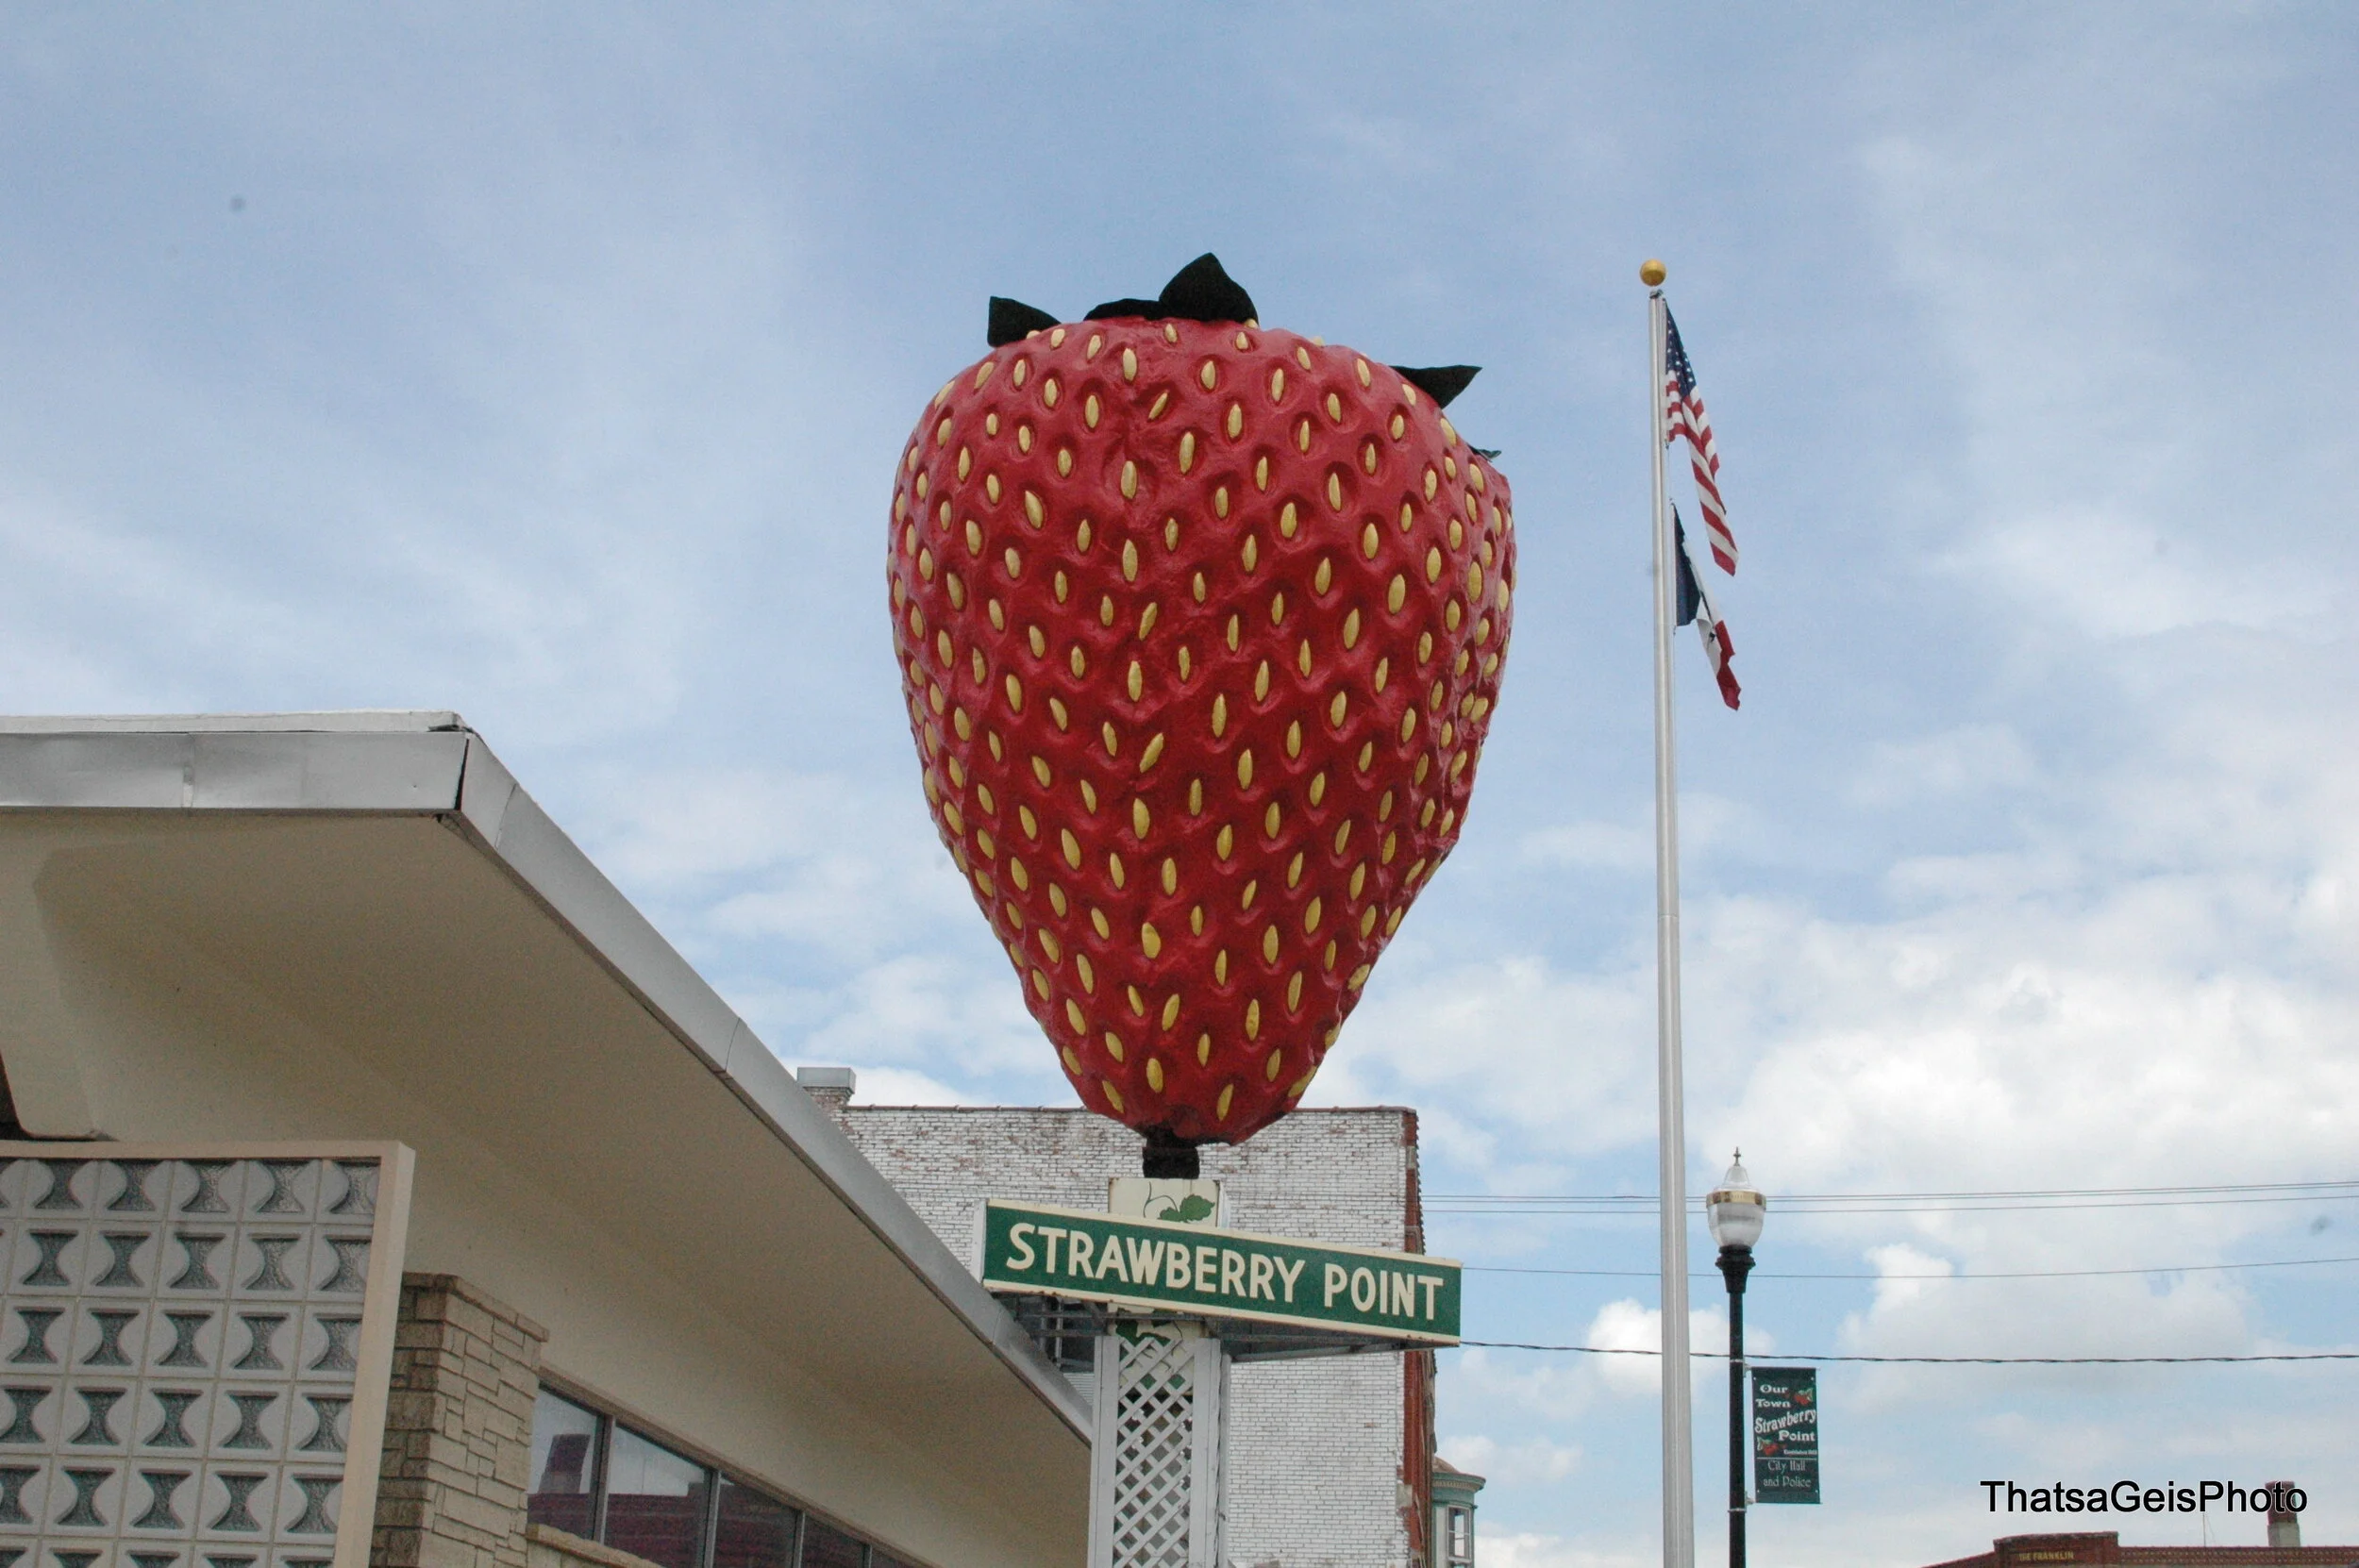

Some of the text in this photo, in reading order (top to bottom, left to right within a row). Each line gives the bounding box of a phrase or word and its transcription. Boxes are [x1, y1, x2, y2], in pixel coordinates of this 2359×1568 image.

[1006, 1223, 1444, 1320] STRAWBERRY POINT
[1760, 1384, 1788, 1393] Our
[1755, 1398, 1791, 1408] Town
[1755, 1409, 1816, 1433] Strawberry
[1779, 1430, 1815, 1442] Point
[1768, 1460, 1806, 1474] City Hall
[1764, 1476, 1812, 1488] and Police
[2033, 1550, 2074, 1561] FRANKLIN
